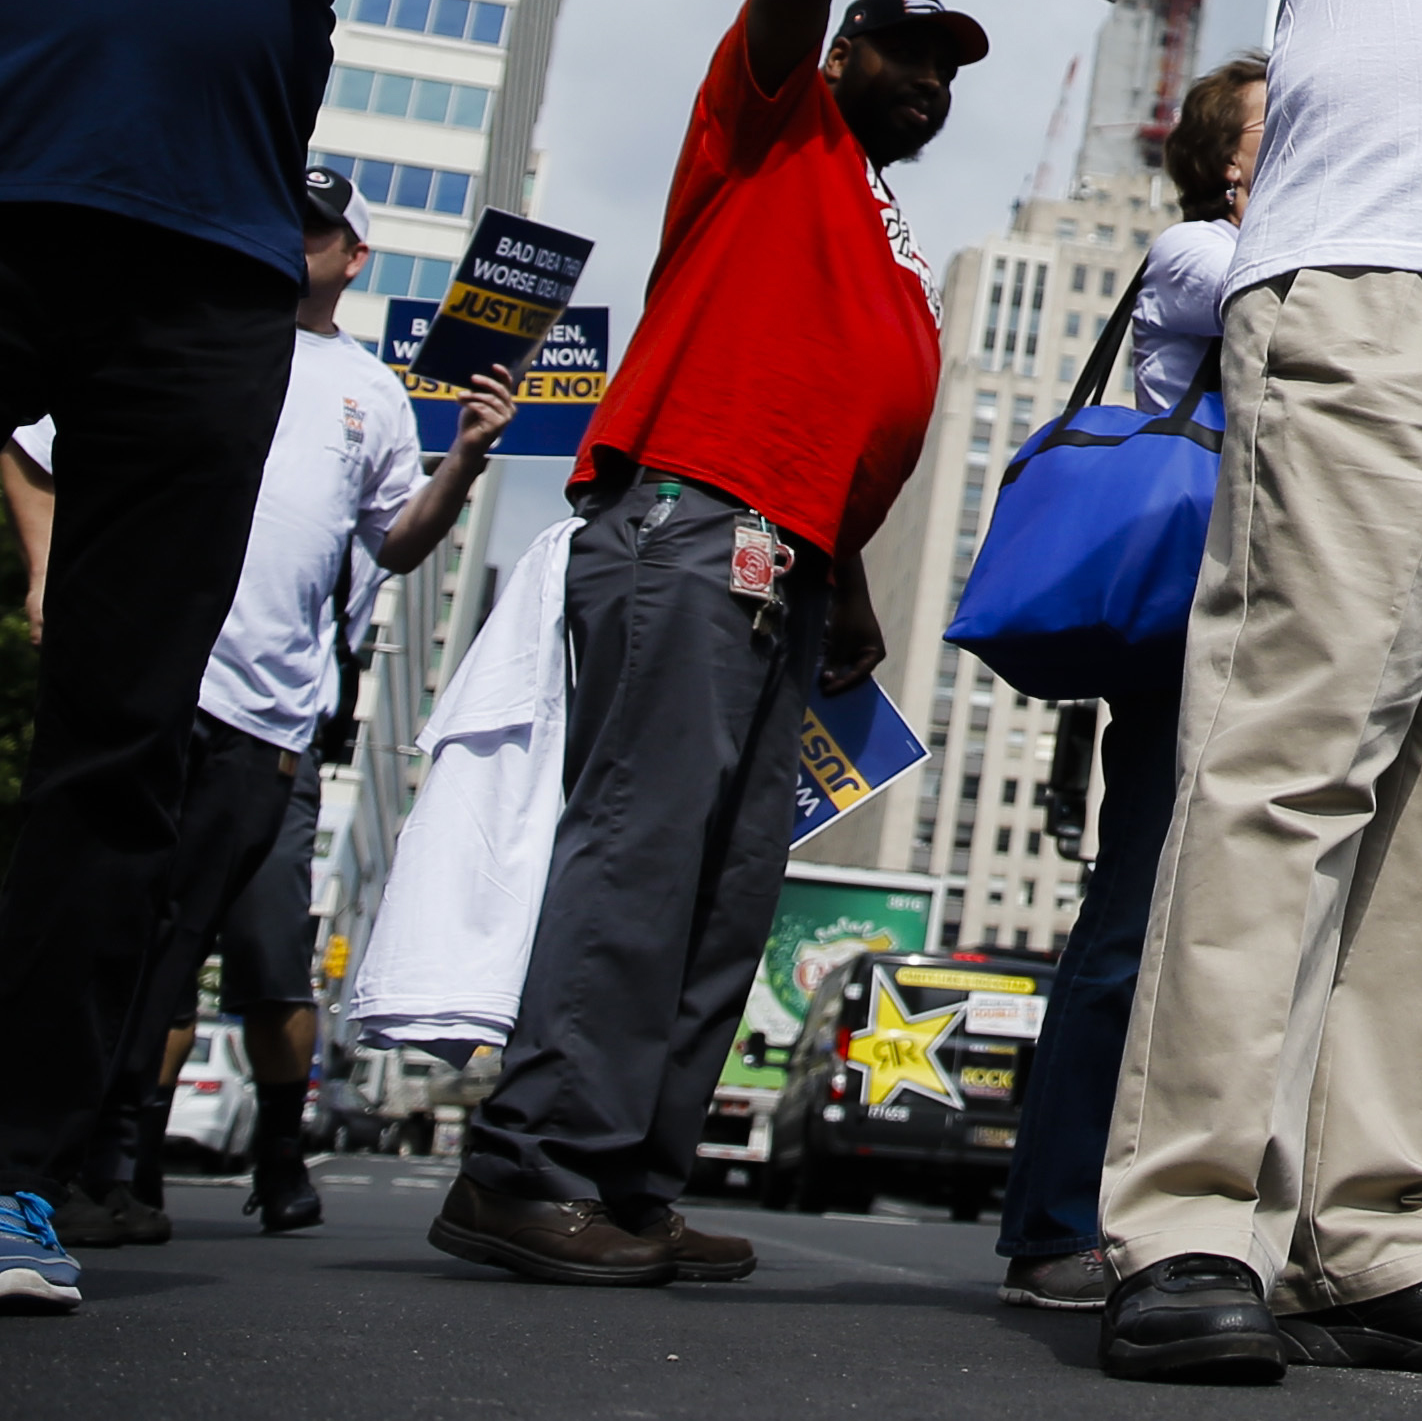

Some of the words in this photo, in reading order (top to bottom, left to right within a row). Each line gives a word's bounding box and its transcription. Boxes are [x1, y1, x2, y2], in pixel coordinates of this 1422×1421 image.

[495, 236, 535, 263] BAD
[534, 248, 562, 271] IDEA
[472, 257, 538, 294] WORSE
[534, 278, 559, 299] IDEA
[450, 289, 519, 327] JUST
[541, 347, 600, 368] NOW,
[550, 376, 601, 398] NO!
